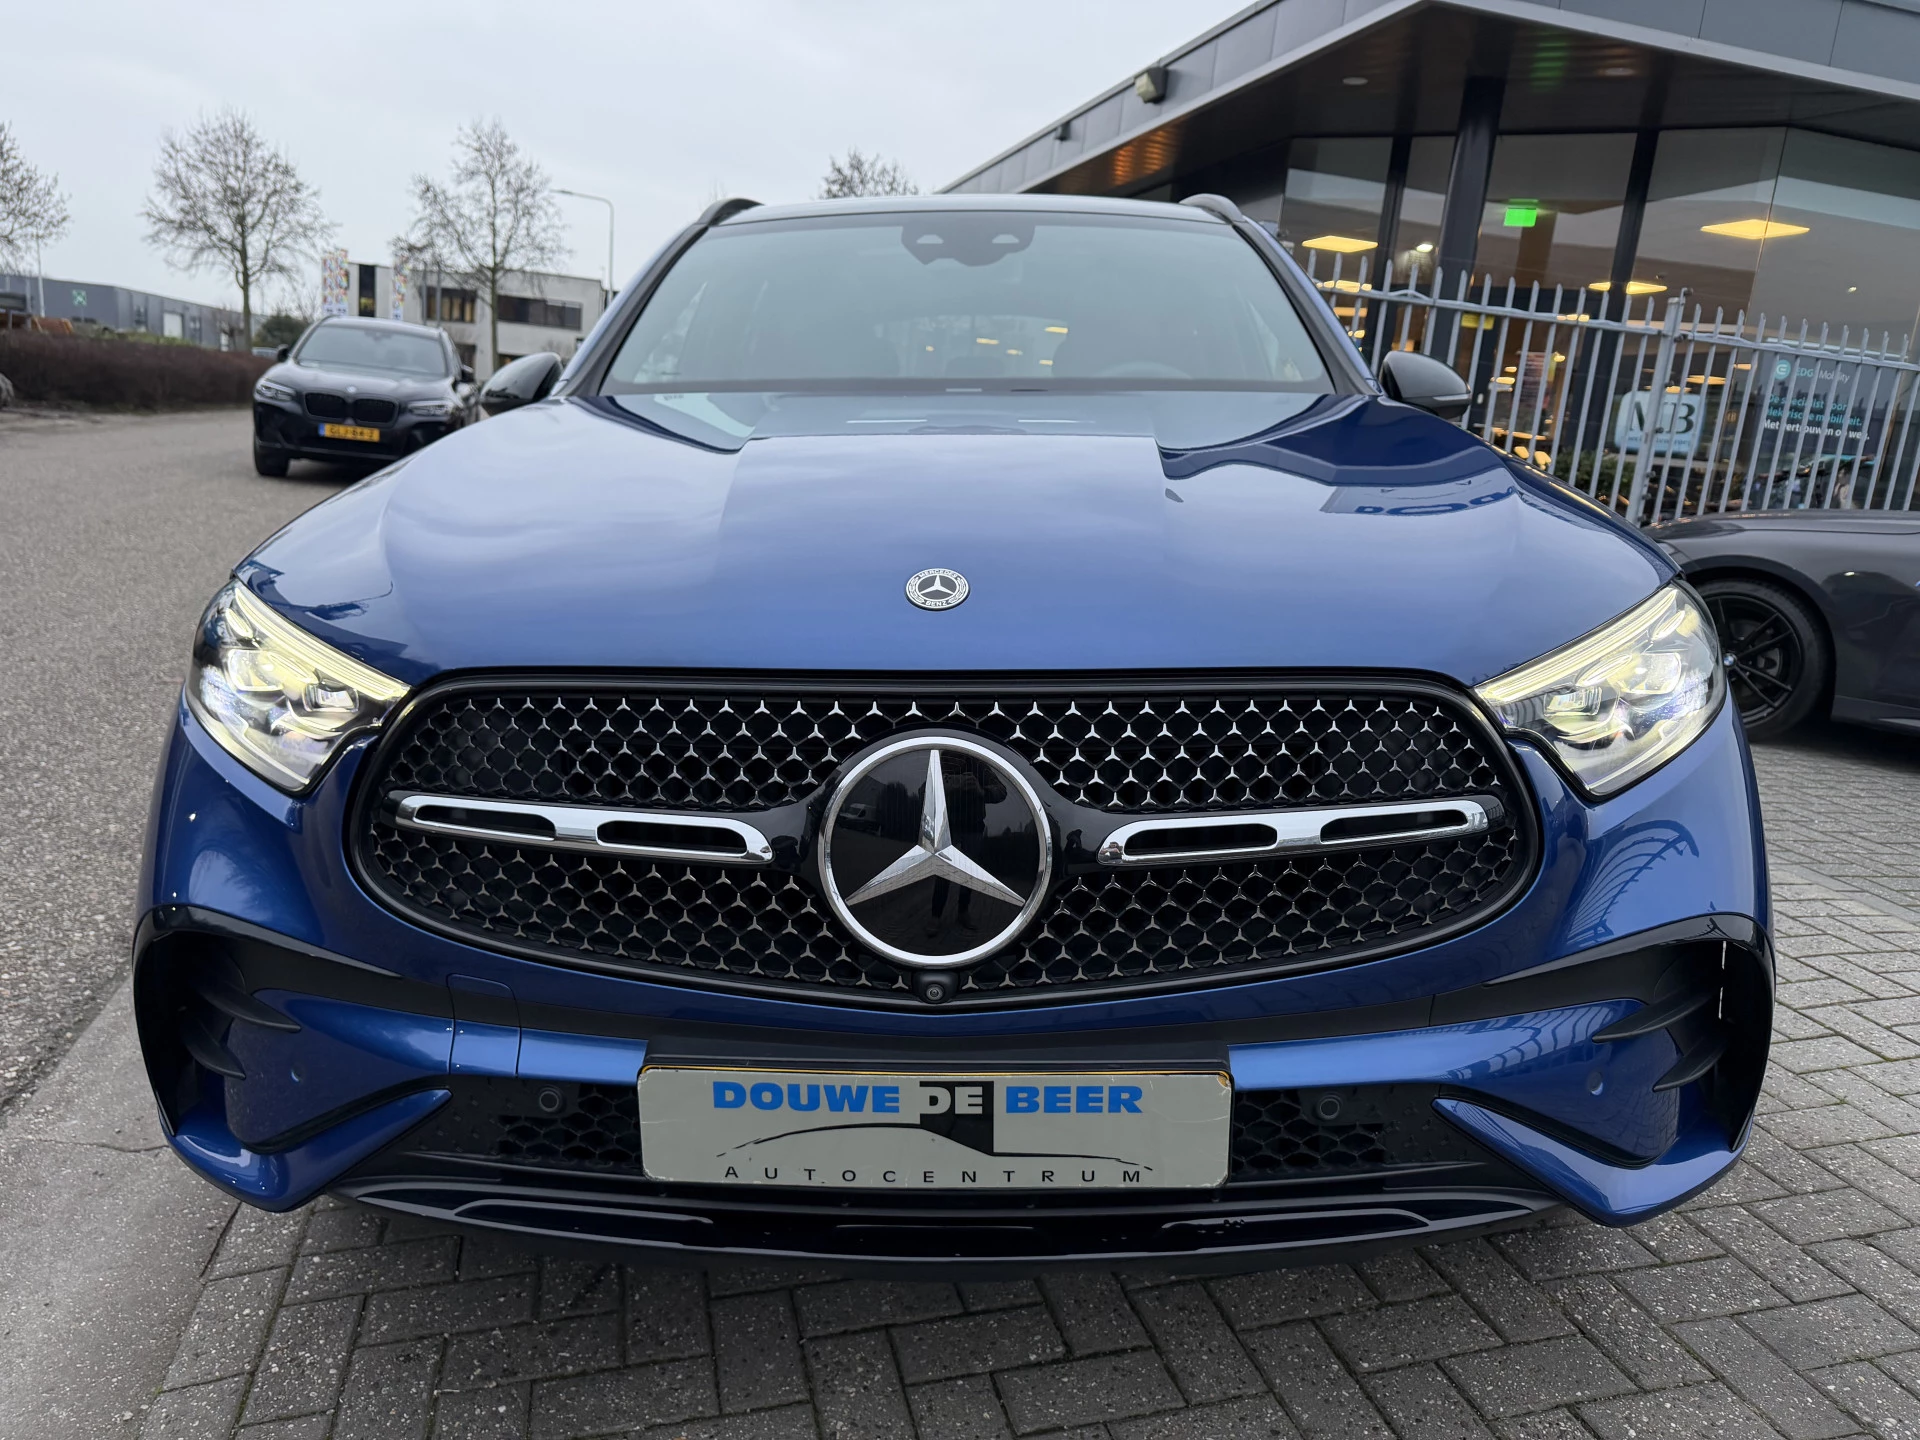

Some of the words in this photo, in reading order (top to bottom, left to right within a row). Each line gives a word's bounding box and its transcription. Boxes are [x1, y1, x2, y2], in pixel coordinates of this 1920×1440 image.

[1816, 414, 1862, 426] mbilieit.
[918, 569, 958, 578] MERCEDES
[712, 1081, 900, 1113] DOUWE
[919, 1086, 983, 1115] DE
[1005, 1085, 1143, 1114] BEER
